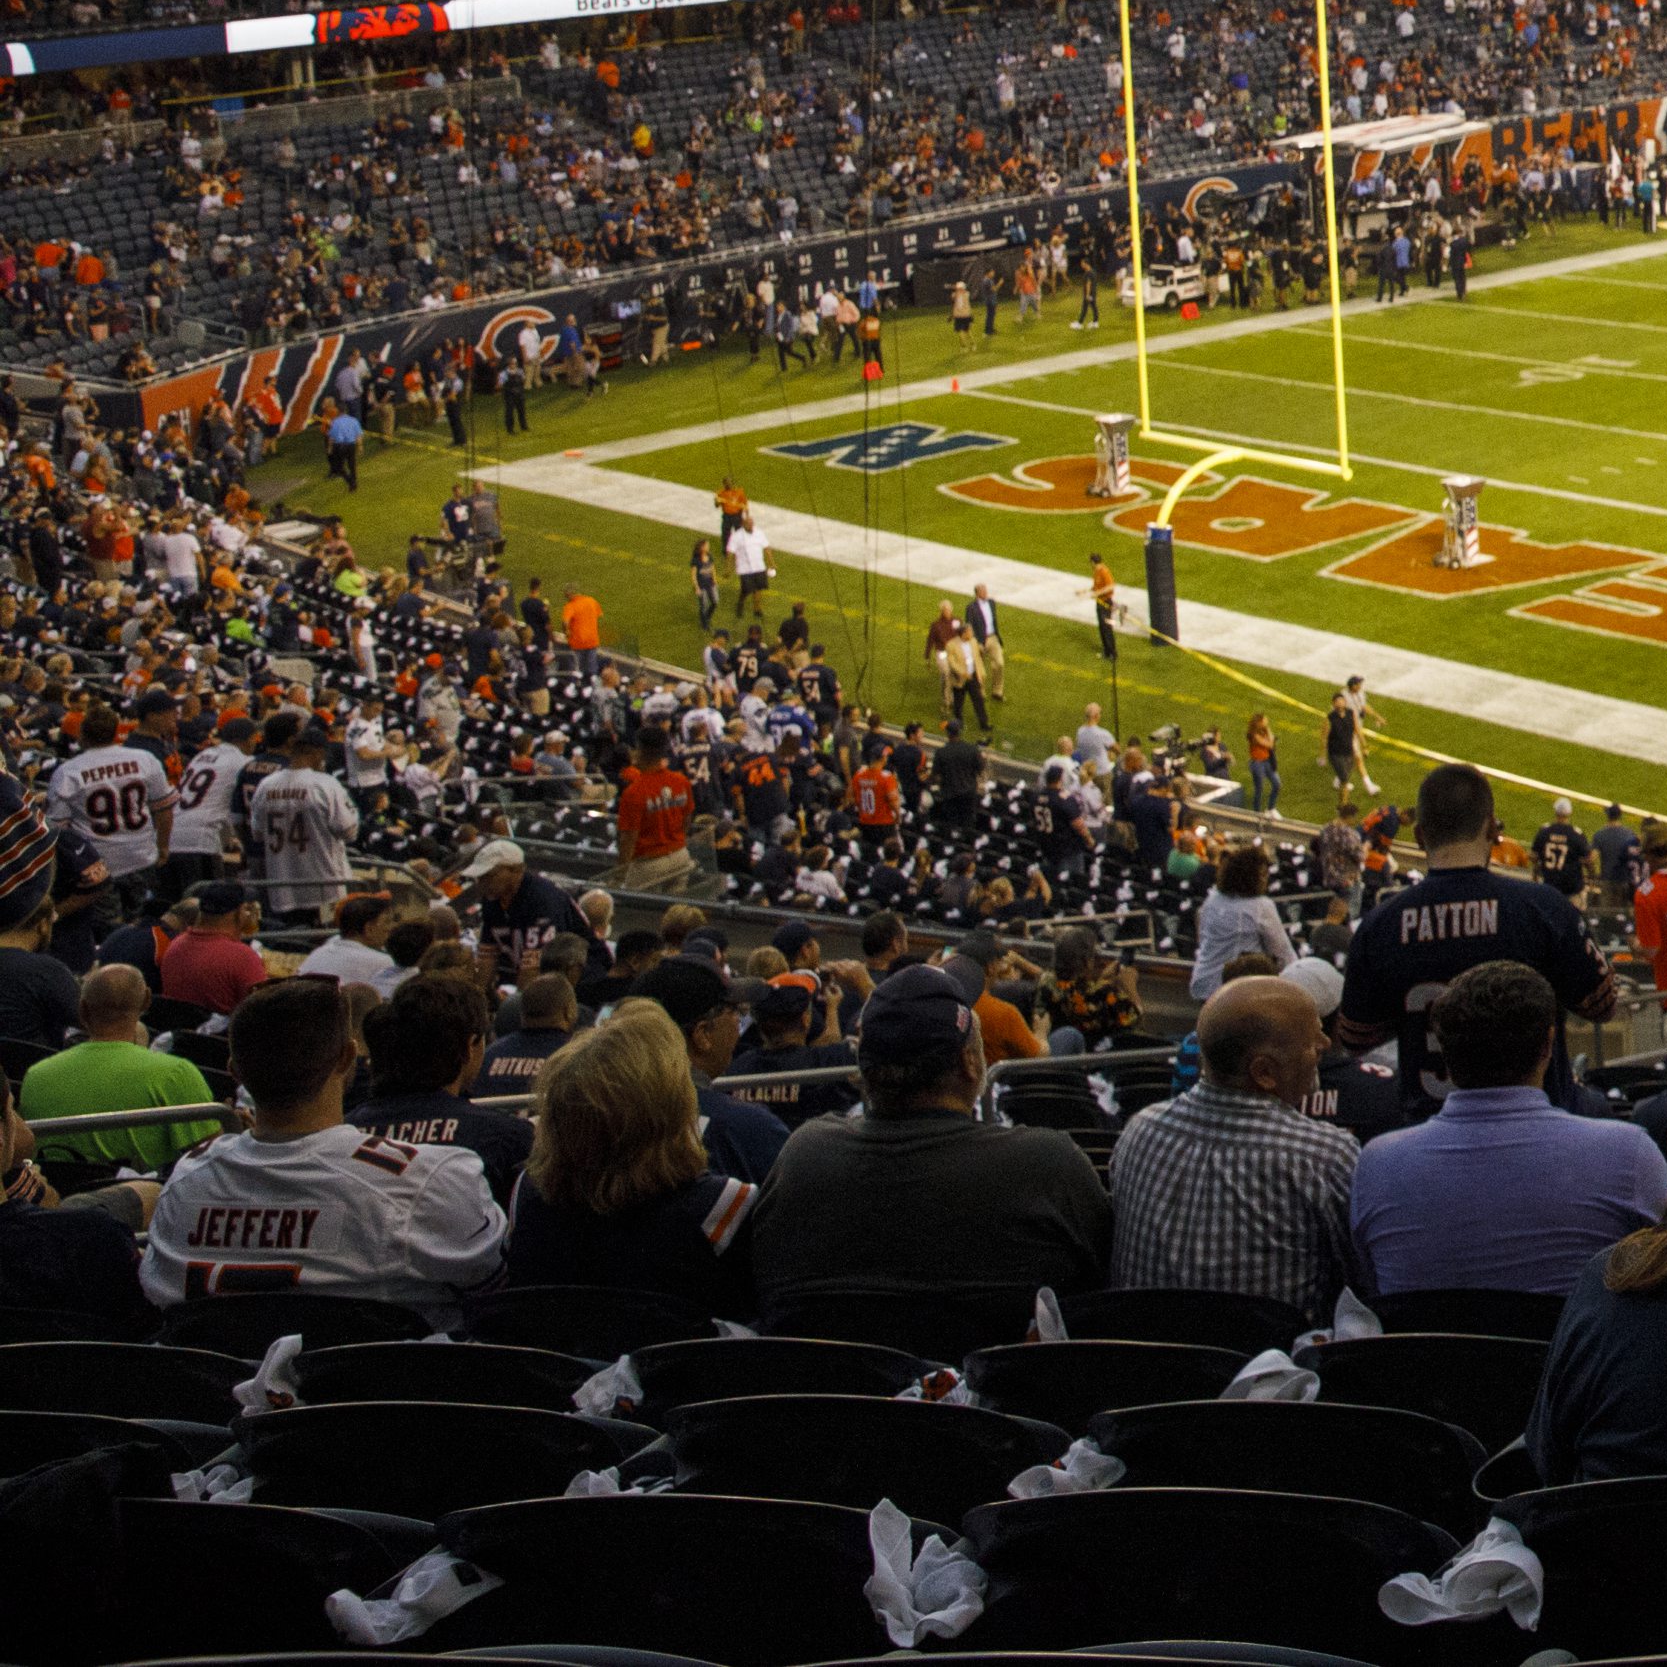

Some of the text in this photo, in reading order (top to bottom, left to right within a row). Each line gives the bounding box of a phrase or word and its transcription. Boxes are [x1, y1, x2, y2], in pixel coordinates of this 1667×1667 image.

[80, 760, 139, 783] PEPPERS
[87, 782, 147, 835] 90
[266, 811, 309, 854] 54
[1545, 843, 1567, 871] 57
[1401, 899, 1499, 946] PAYTON
[188, 1207, 320, 1249] JEFFERY
